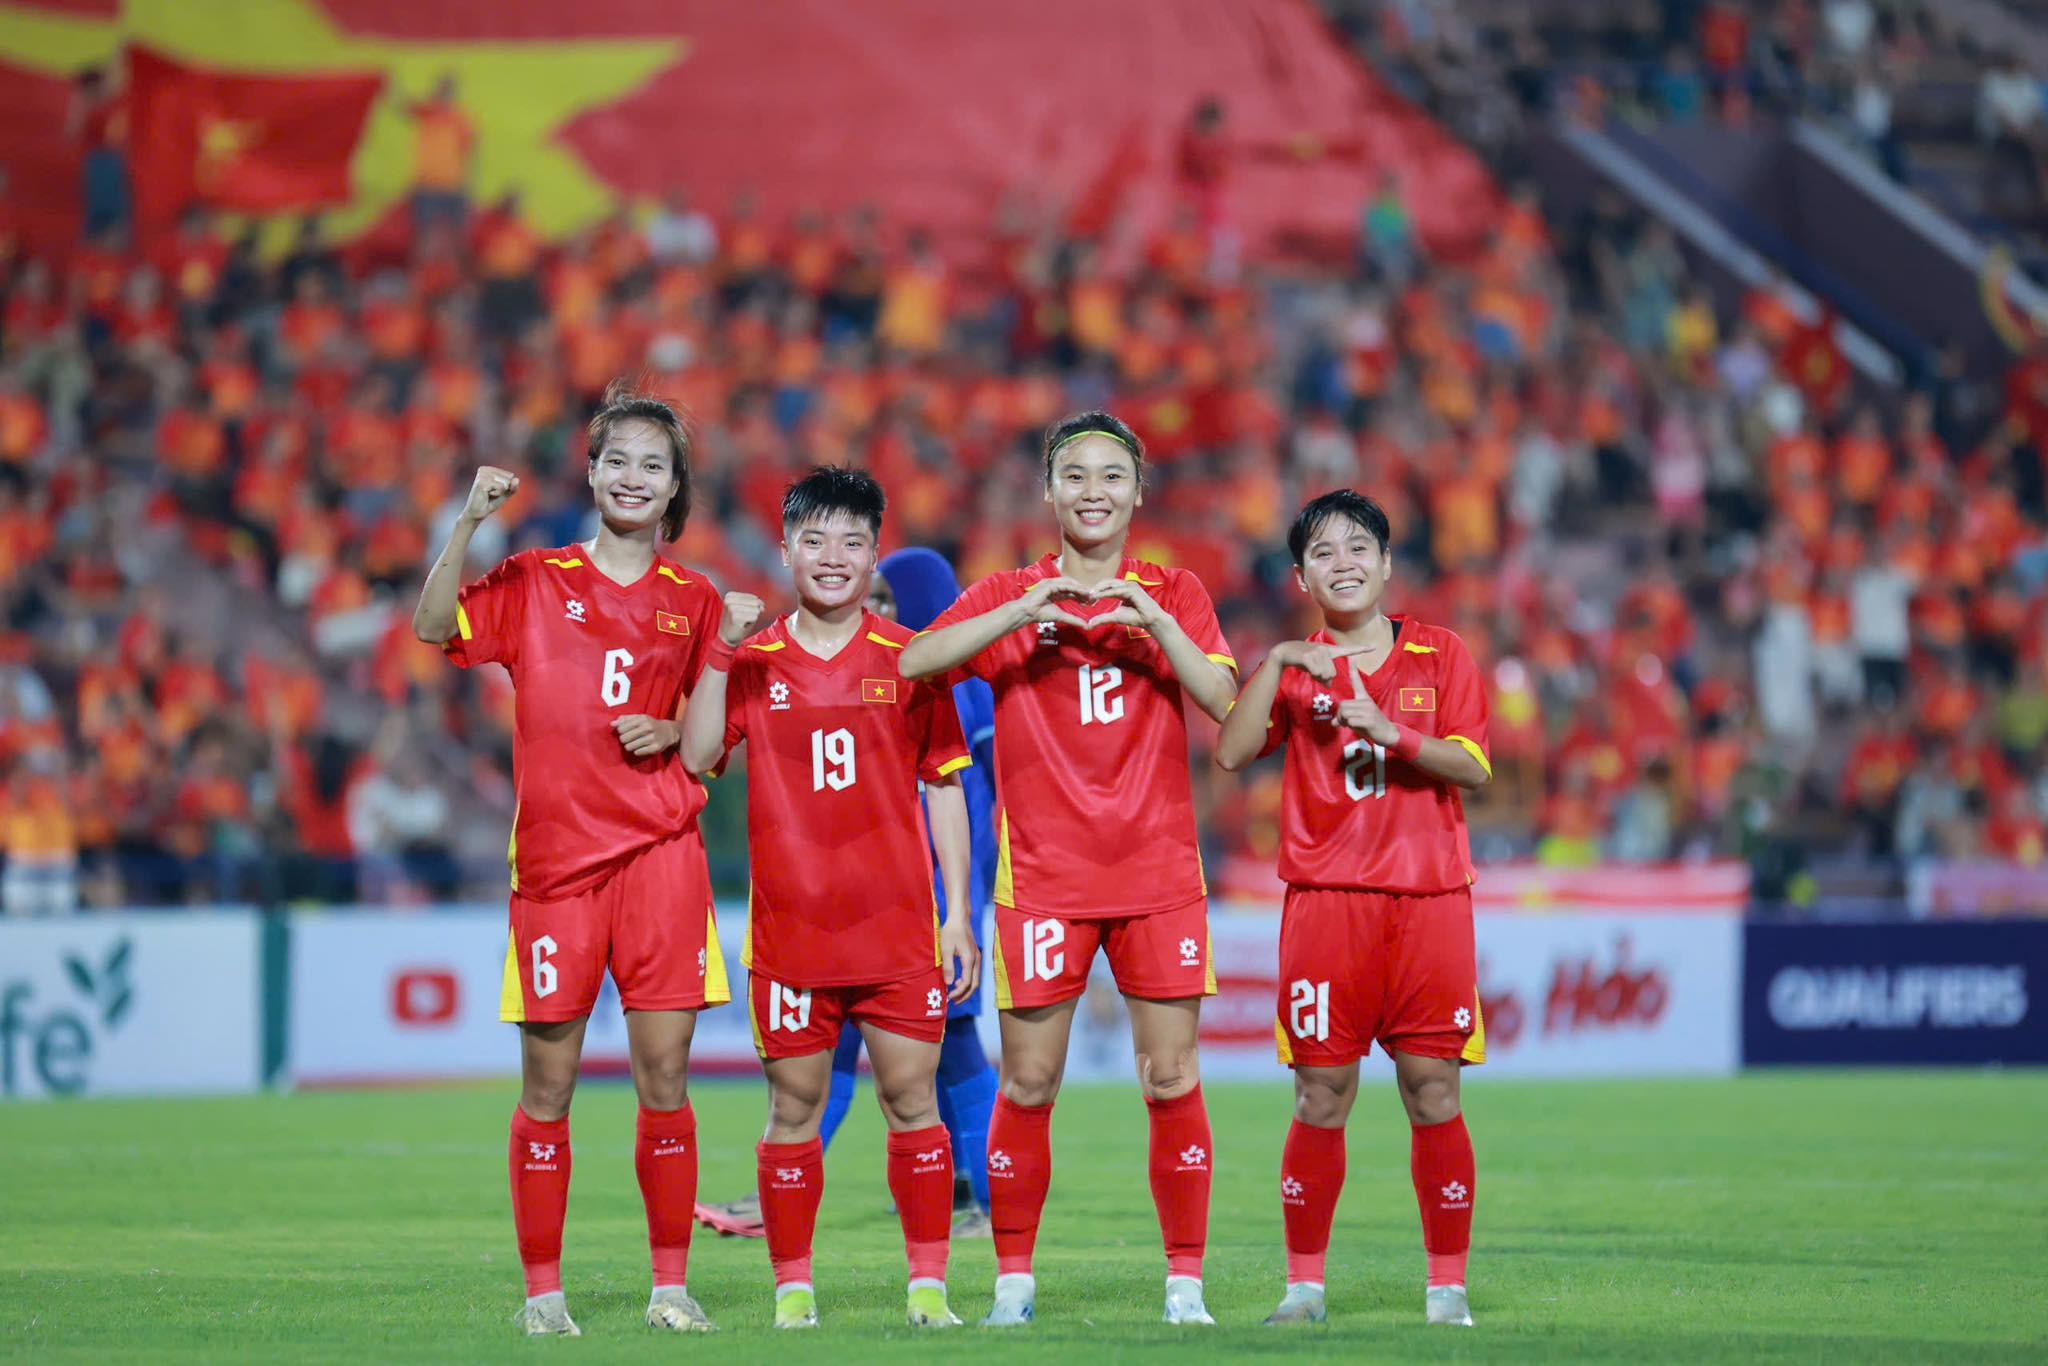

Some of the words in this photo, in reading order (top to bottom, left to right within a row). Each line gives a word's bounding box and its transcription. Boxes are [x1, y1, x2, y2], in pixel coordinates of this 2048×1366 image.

[601, 648, 634, 707] 6
[1078, 663, 1124, 726] 12
[811, 727, 857, 792] 19
[1343, 738, 1386, 801] 21
[531, 934, 558, 999] 6
[1023, 918, 1065, 983] 12
[769, 980, 812, 1033] 19
[1291, 978, 1330, 1043] 21
[1768, 965, 2028, 1030] QUALIFIERS
